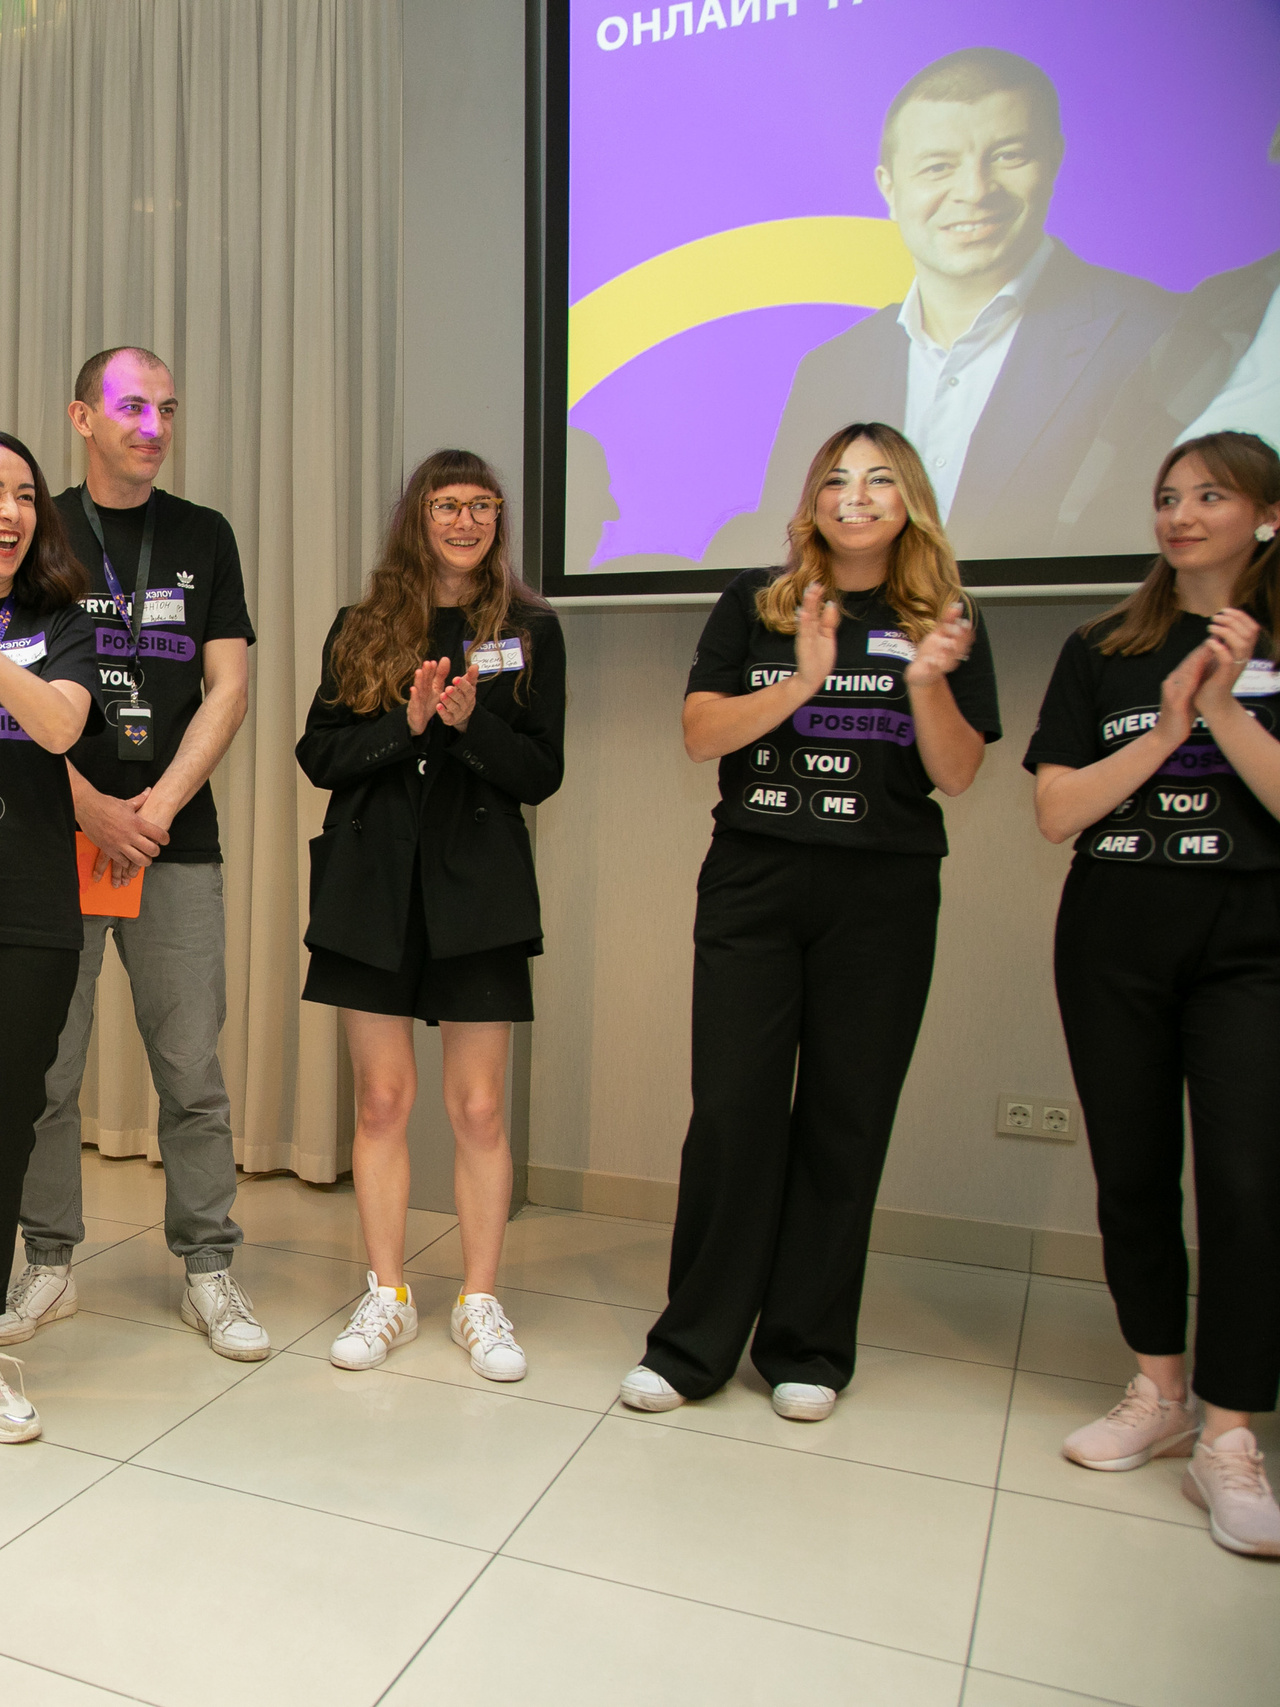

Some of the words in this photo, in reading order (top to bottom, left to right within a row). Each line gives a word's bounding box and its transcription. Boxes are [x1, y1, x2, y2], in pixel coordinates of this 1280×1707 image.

[145, 590, 173, 599] ХЭЛОУ
[0, 639, 32, 650] ХЭЛОУ
[99, 669, 133, 686] YOU
[750, 669, 894, 692] EVETHING
[809, 713, 911, 739] POSSIBLE
[757, 749, 770, 766] IF
[804, 753, 850, 774] YOU
[749, 788, 788, 808] ARE
[823, 796, 856, 815] ME
[1157, 792, 1209, 813] YOU
[1096, 835, 1140, 853] ARE
[1178, 835, 1219, 855] ME
